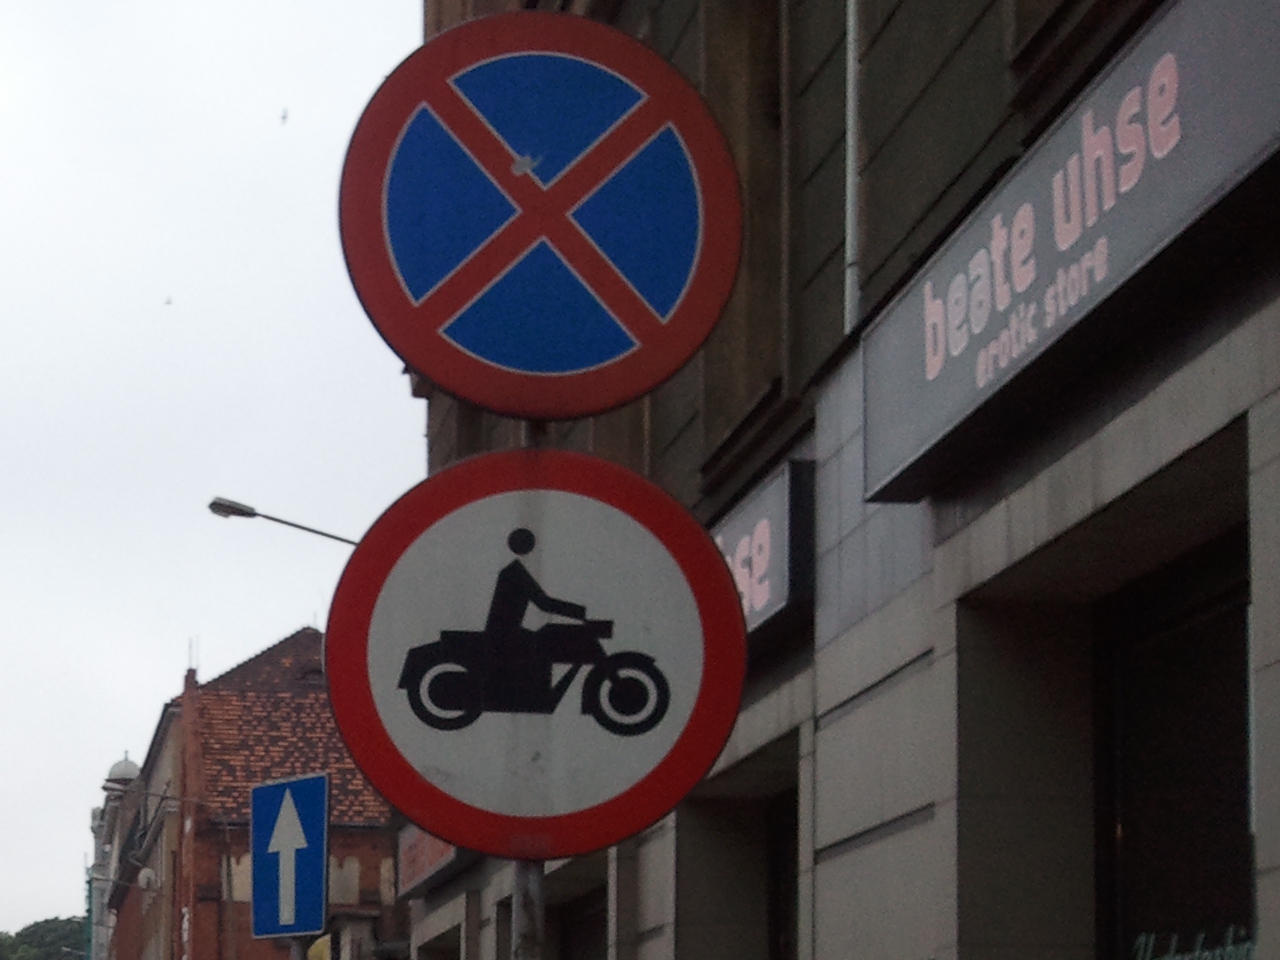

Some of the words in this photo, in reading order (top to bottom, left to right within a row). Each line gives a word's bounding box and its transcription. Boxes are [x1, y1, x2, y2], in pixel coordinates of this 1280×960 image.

[923, 202, 1037, 381] beate
[1052, 52, 1182, 251] uhse
[976, 301, 1038, 389] erotic
[1044, 236, 1109, 328] store
[715, 519, 772, 616] se
